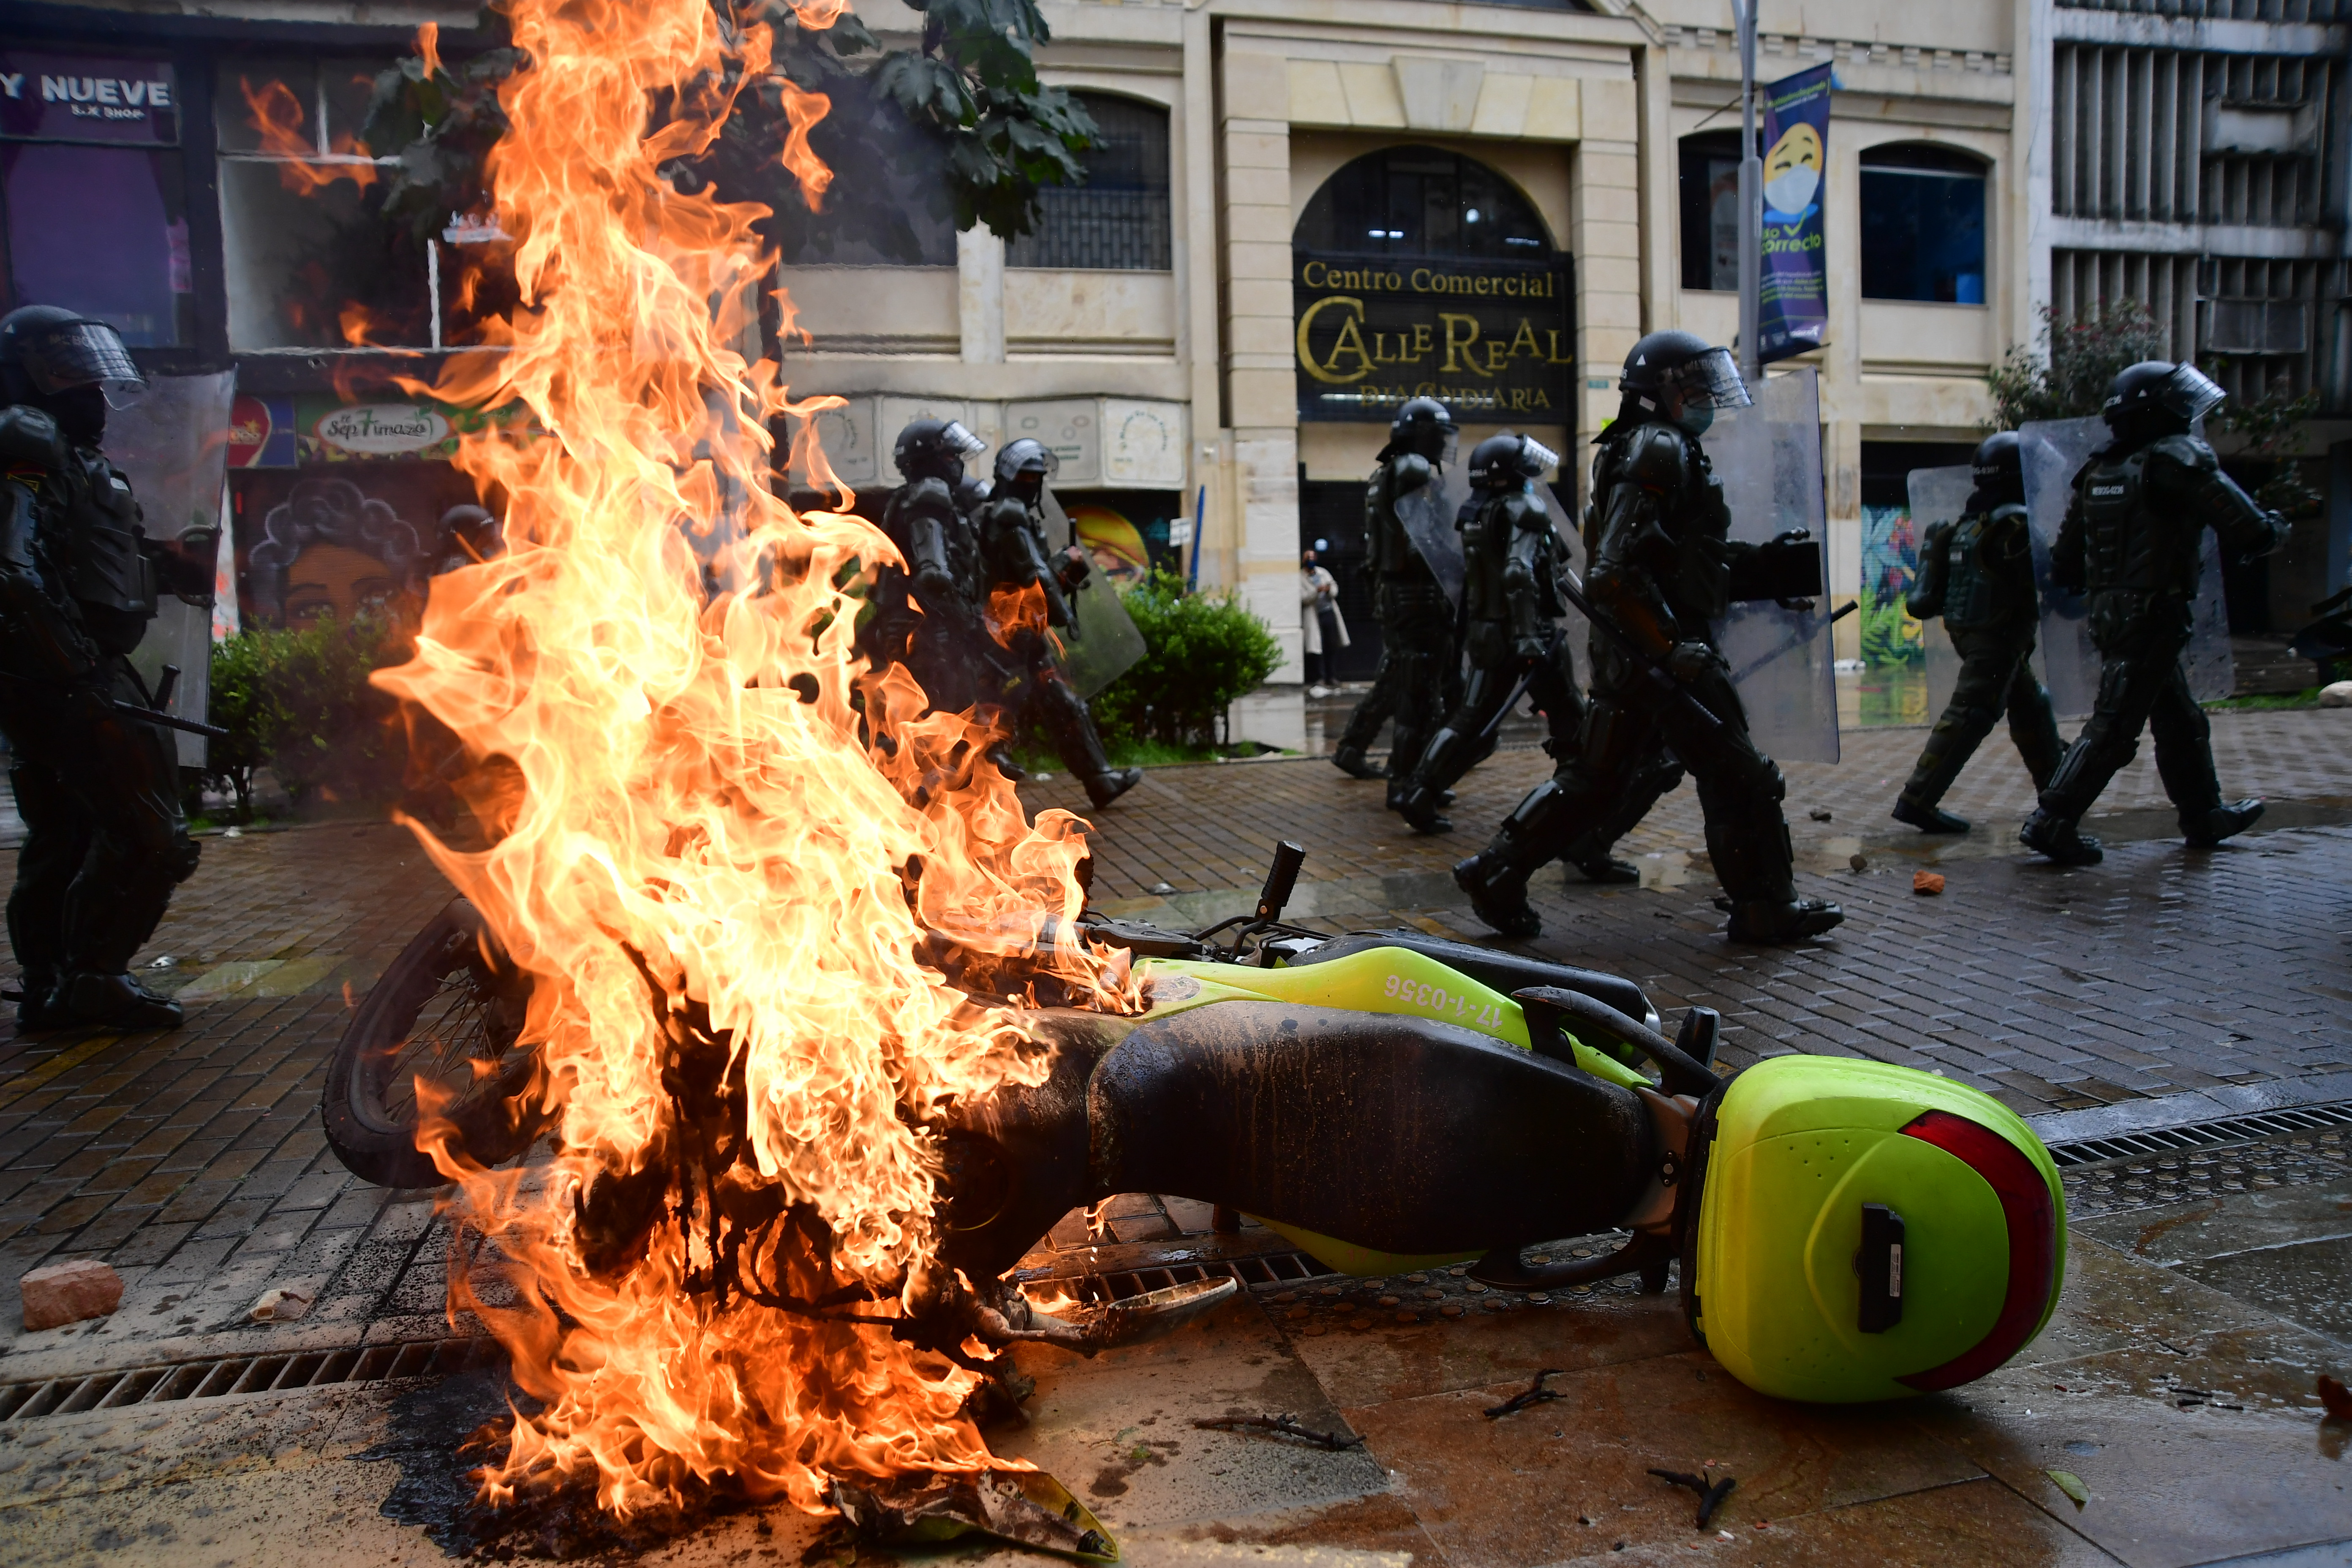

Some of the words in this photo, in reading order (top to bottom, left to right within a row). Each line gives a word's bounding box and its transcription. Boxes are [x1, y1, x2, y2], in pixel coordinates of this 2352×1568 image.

[0, 73, 24, 99] Y
[40, 75, 172, 106] NUEVE
[104, 106, 146, 120] SHOP
[1303, 261, 1402, 290] Centro
[1411, 268, 1553, 297] Comercial
[1384, 975, 1503, 1029] 17-1-0356
